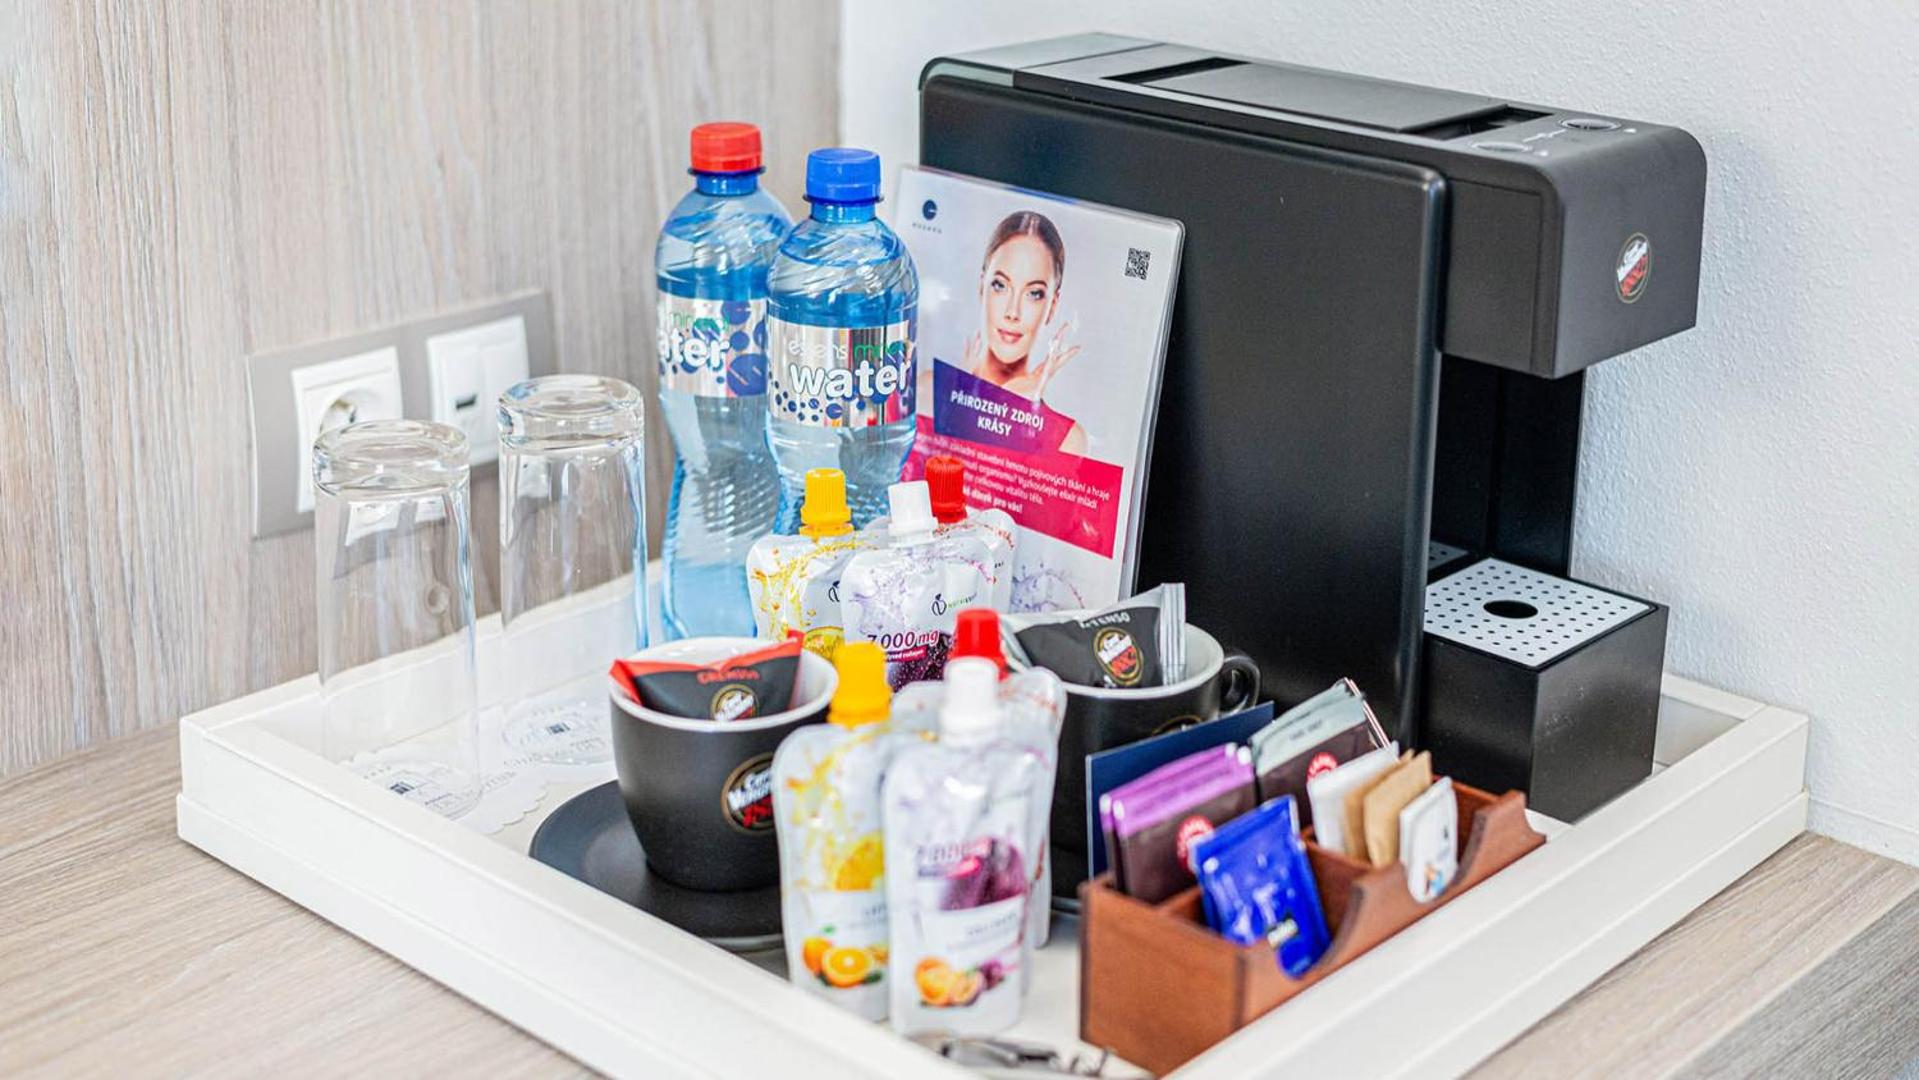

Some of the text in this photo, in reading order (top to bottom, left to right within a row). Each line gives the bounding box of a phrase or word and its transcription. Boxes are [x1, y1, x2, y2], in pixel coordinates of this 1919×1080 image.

[789, 359, 911, 399] water
[950, 391, 1044, 431] PŘIROZENÝ ZDROJ
[977, 416, 1012, 436] KRÁSY
[918, 629, 940, 645] mg
